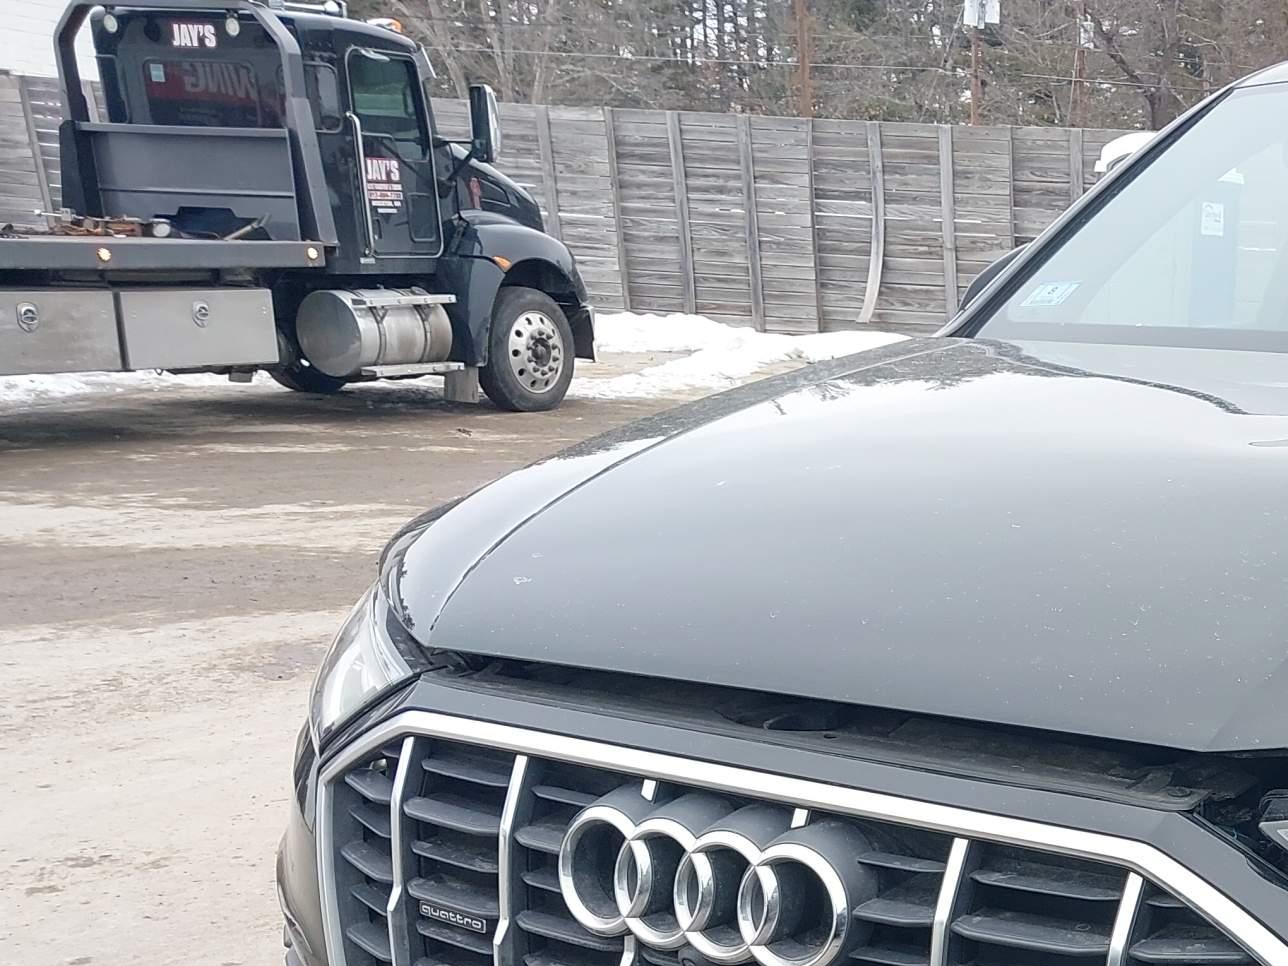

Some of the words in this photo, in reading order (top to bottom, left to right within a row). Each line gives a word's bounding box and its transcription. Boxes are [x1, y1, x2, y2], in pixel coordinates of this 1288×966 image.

[172, 23, 217, 48] JAY'S
[366, 159, 401, 181] JAY'S
[421, 904, 482, 929] quattro
